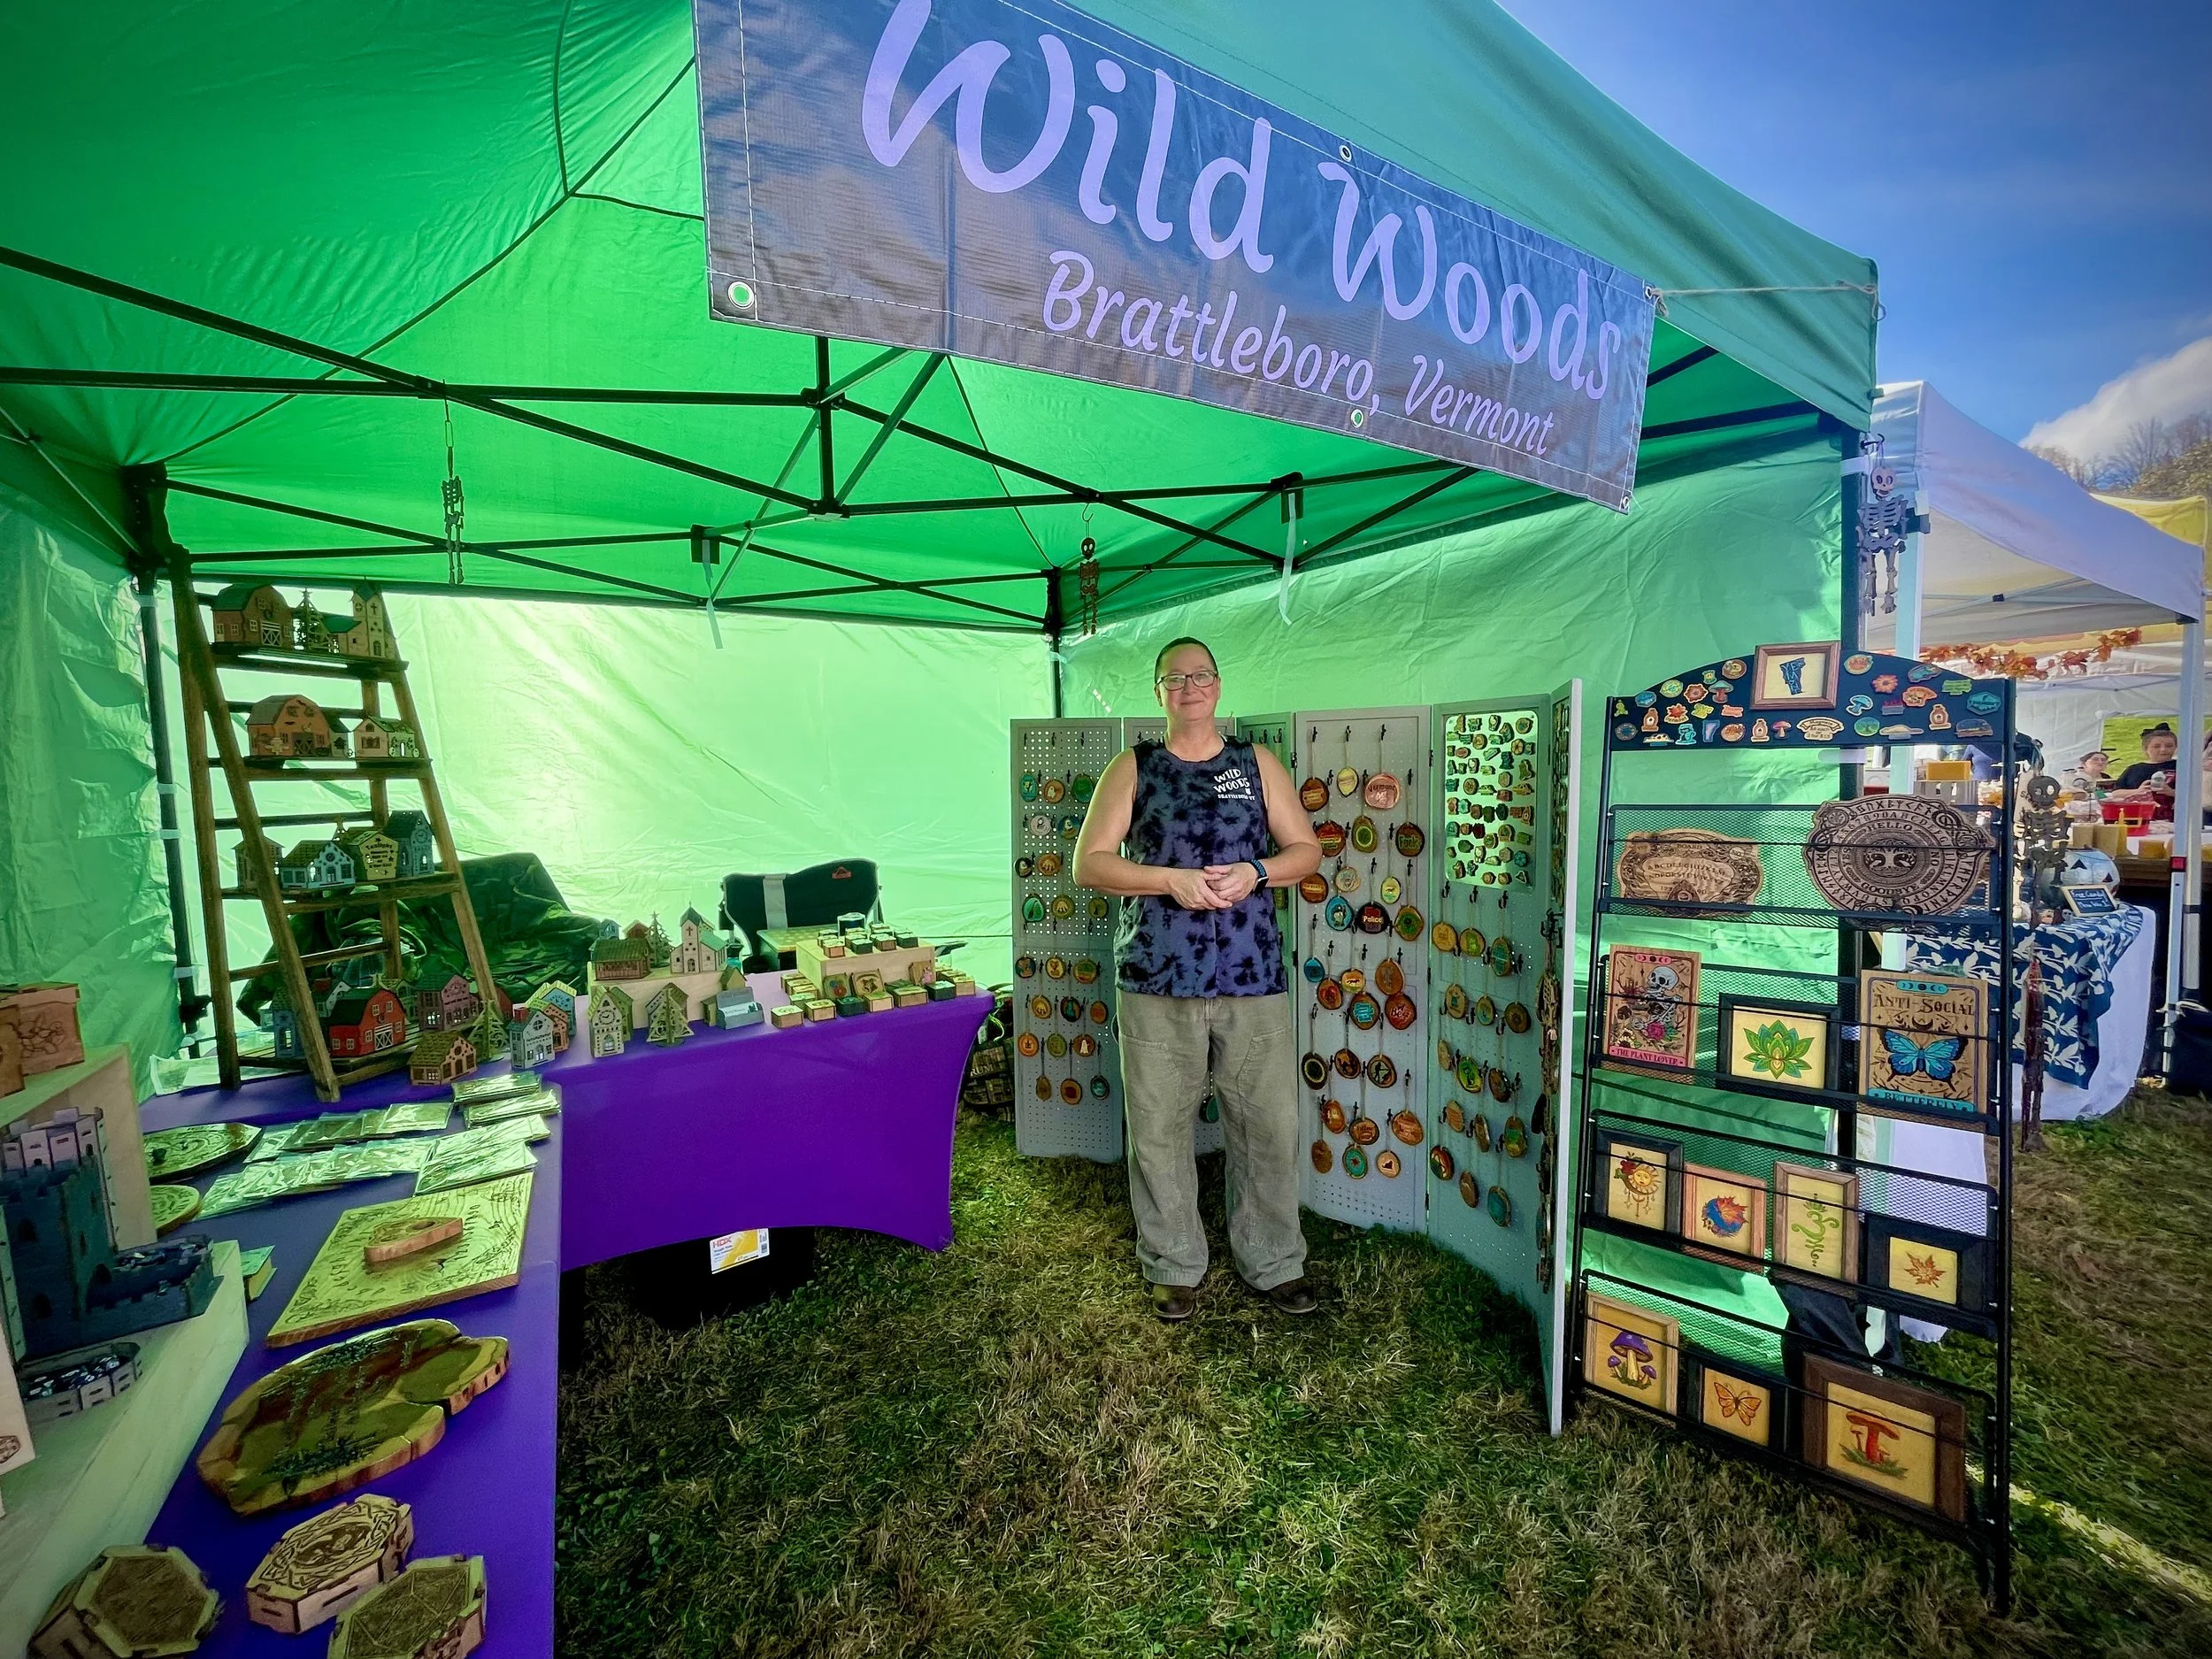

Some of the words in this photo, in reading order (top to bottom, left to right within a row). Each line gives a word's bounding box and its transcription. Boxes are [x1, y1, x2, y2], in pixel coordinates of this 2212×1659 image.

[862, 0, 1273, 273] Wild
[1317, 162, 1620, 399] Woods
[1042, 250, 1379, 415] Brattleboro,
[1404, 355, 1555, 455] Vermont
[1213, 769, 1241, 783] WILD
[1213, 778, 1250, 793] WOODS
[1368, 784, 1396, 793] Vermont
[1867, 820, 1913, 832] HELLO
[1843, 847, 1852, 867] YES
[1931, 851, 1939, 867] NO
[1861, 882, 1920, 895] GOODBYE
[1631, 1050, 1653, 1061] PLANT
[1654, 1056, 1678, 1065] LOVER
[712, 1237, 733, 1249] HDX
